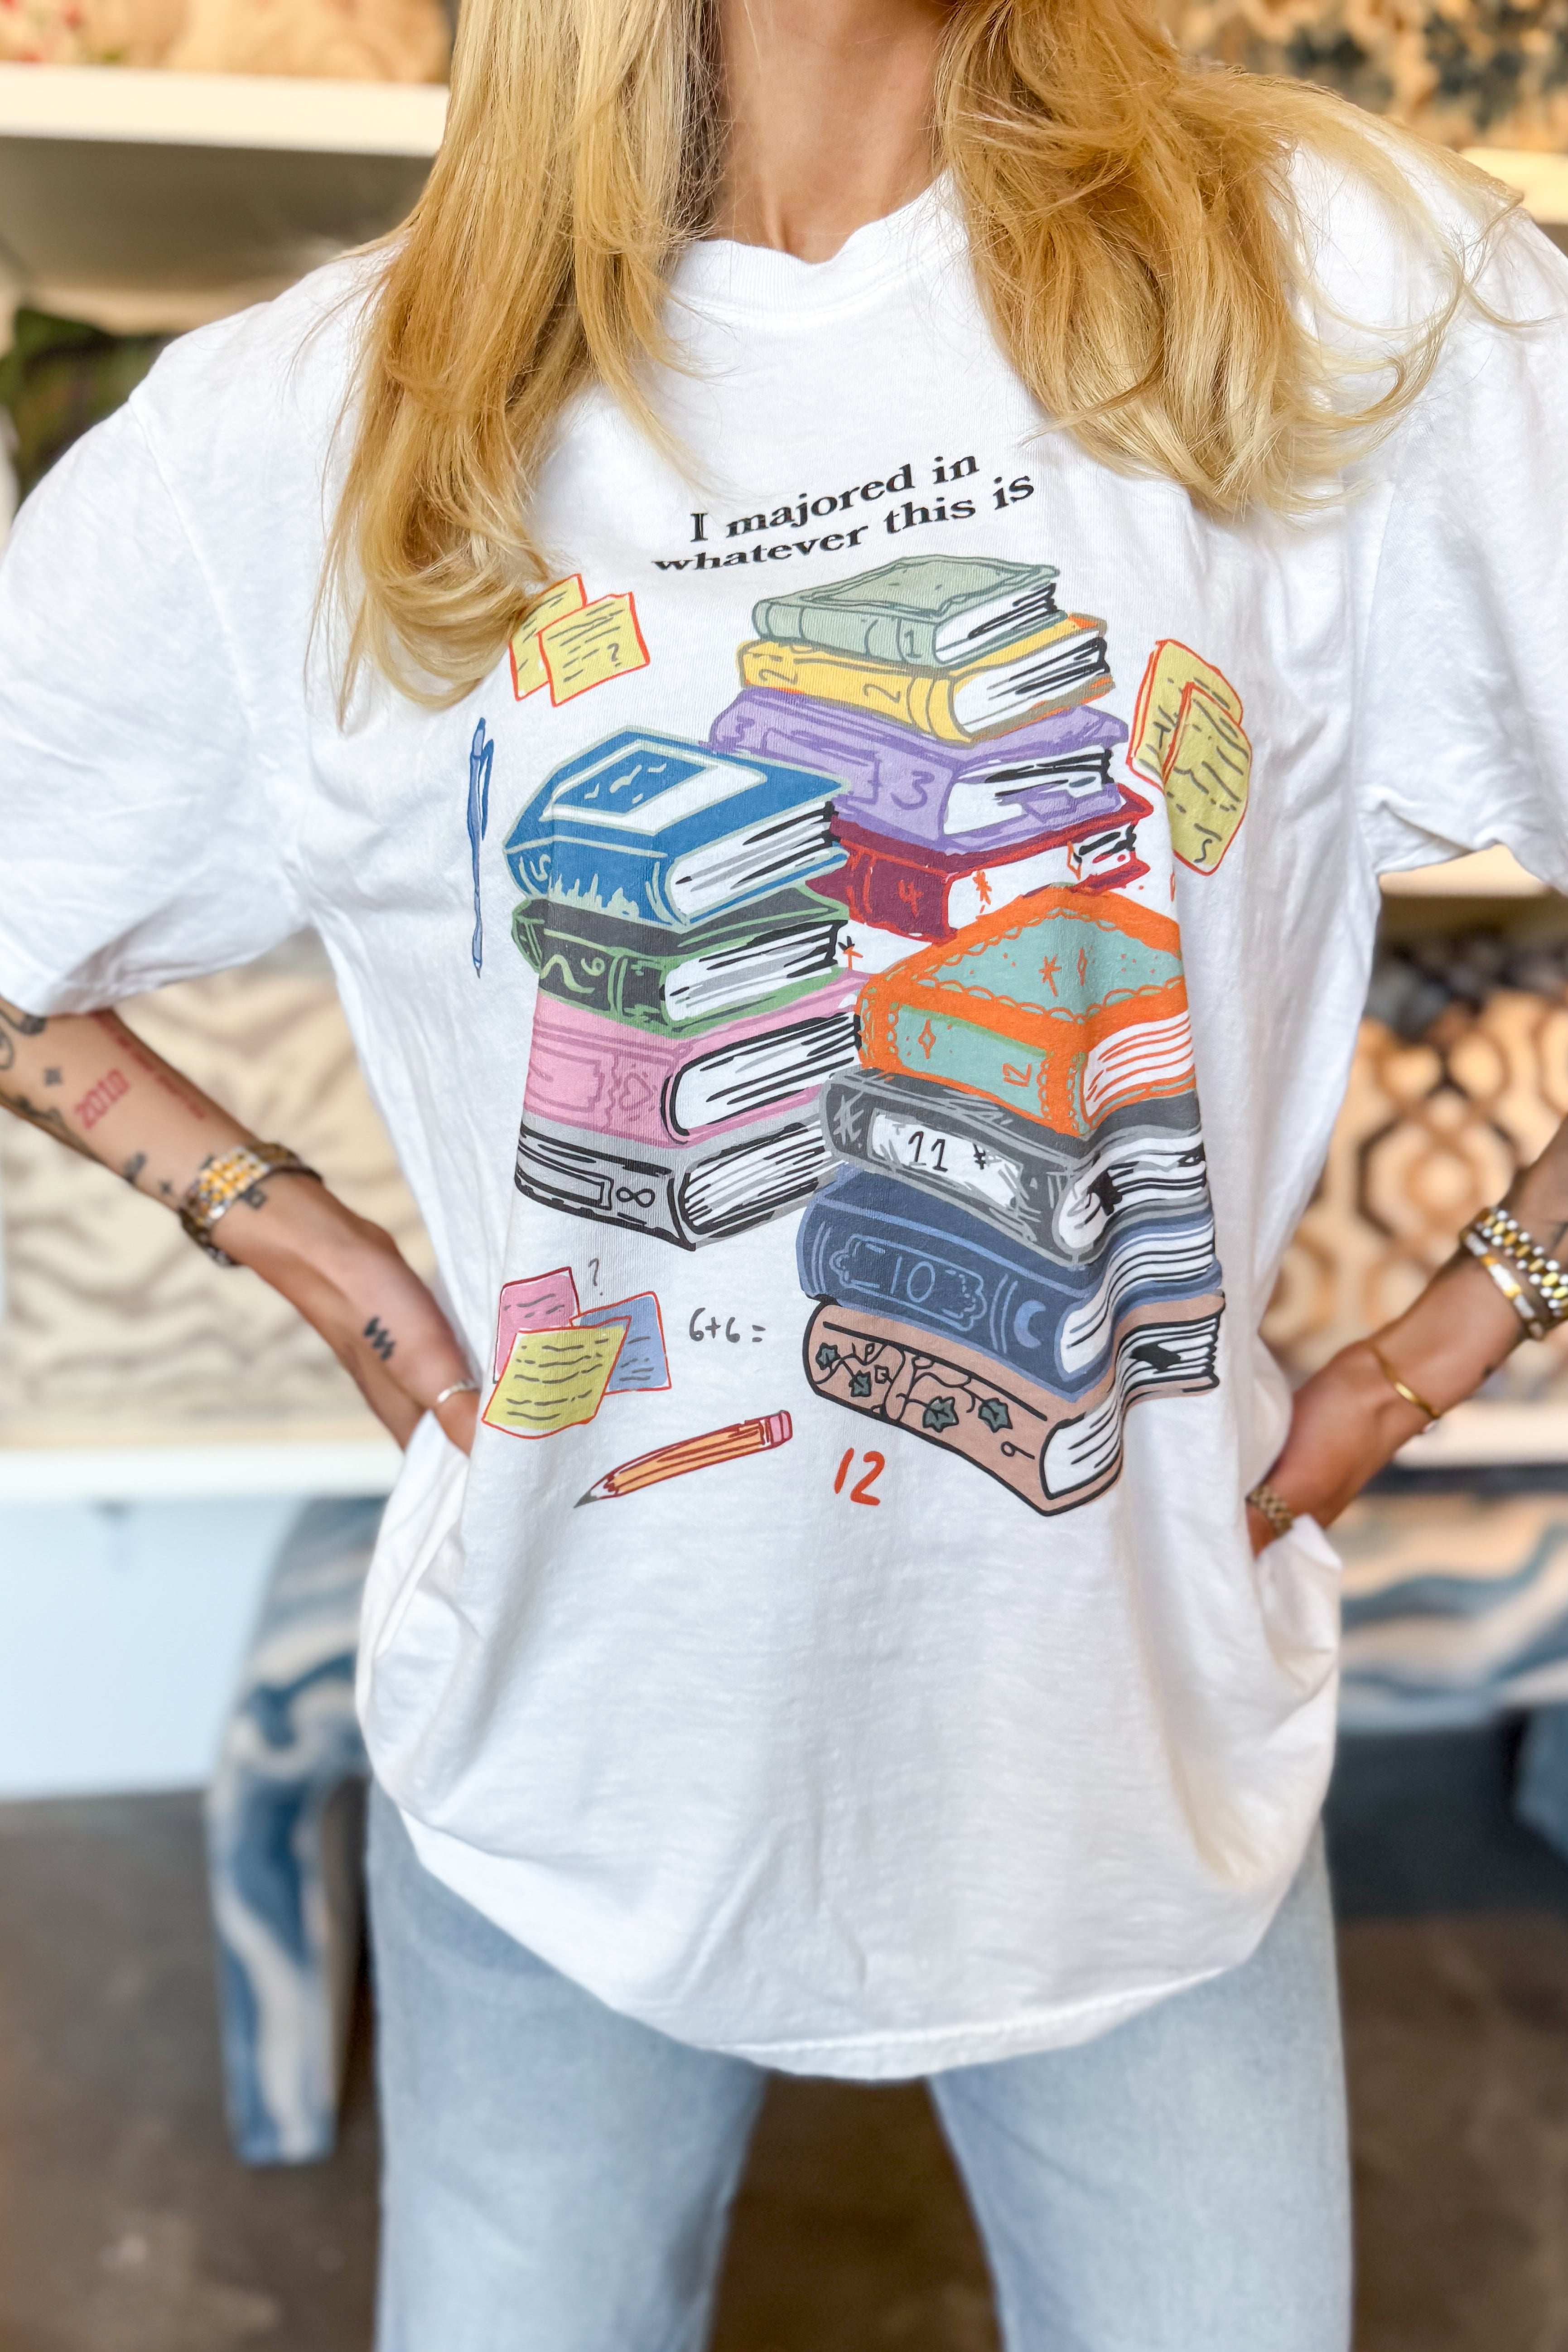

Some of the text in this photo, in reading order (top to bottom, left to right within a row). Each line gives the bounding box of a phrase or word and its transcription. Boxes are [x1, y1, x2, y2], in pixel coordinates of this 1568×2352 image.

[690, 455, 980, 542] I majored in
[651, 475, 1035, 570] whatever this is
[904, 629, 923, 658] 1
[900, 771, 935, 811] 3
[907, 1130, 948, 1173] 11
[890, 1257, 937, 1303] 10
[834, 1447, 886, 1506] 12
